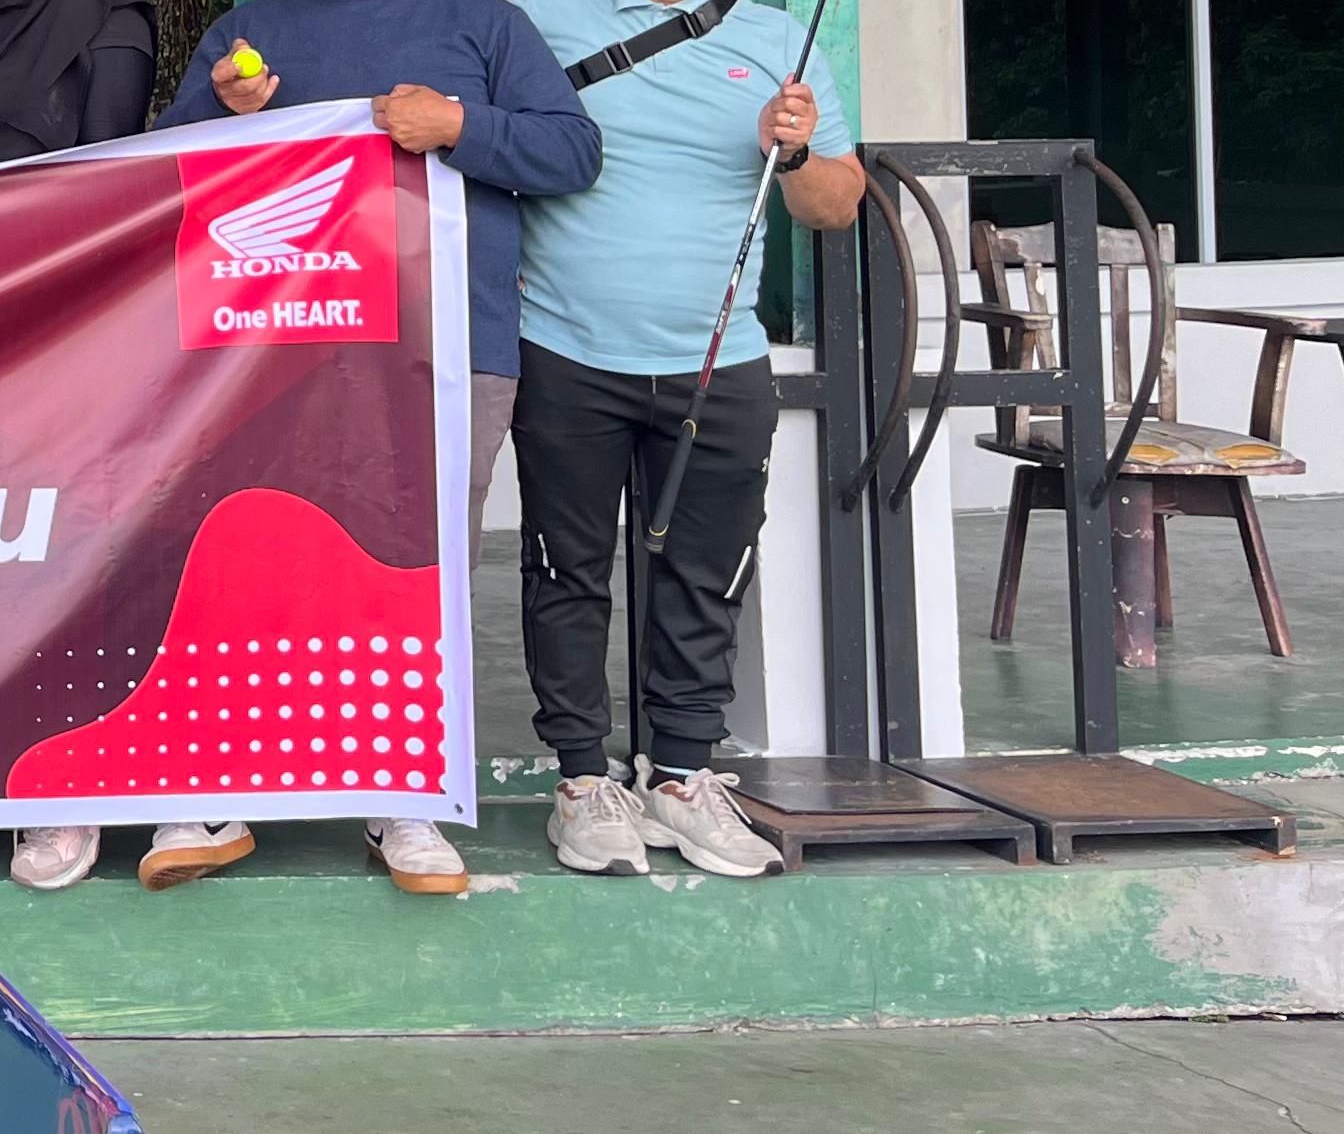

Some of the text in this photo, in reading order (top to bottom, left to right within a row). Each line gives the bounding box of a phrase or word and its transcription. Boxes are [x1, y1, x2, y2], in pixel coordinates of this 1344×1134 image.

[210, 251, 362, 279] HONDA
[213, 299, 363, 331] One HEART.
